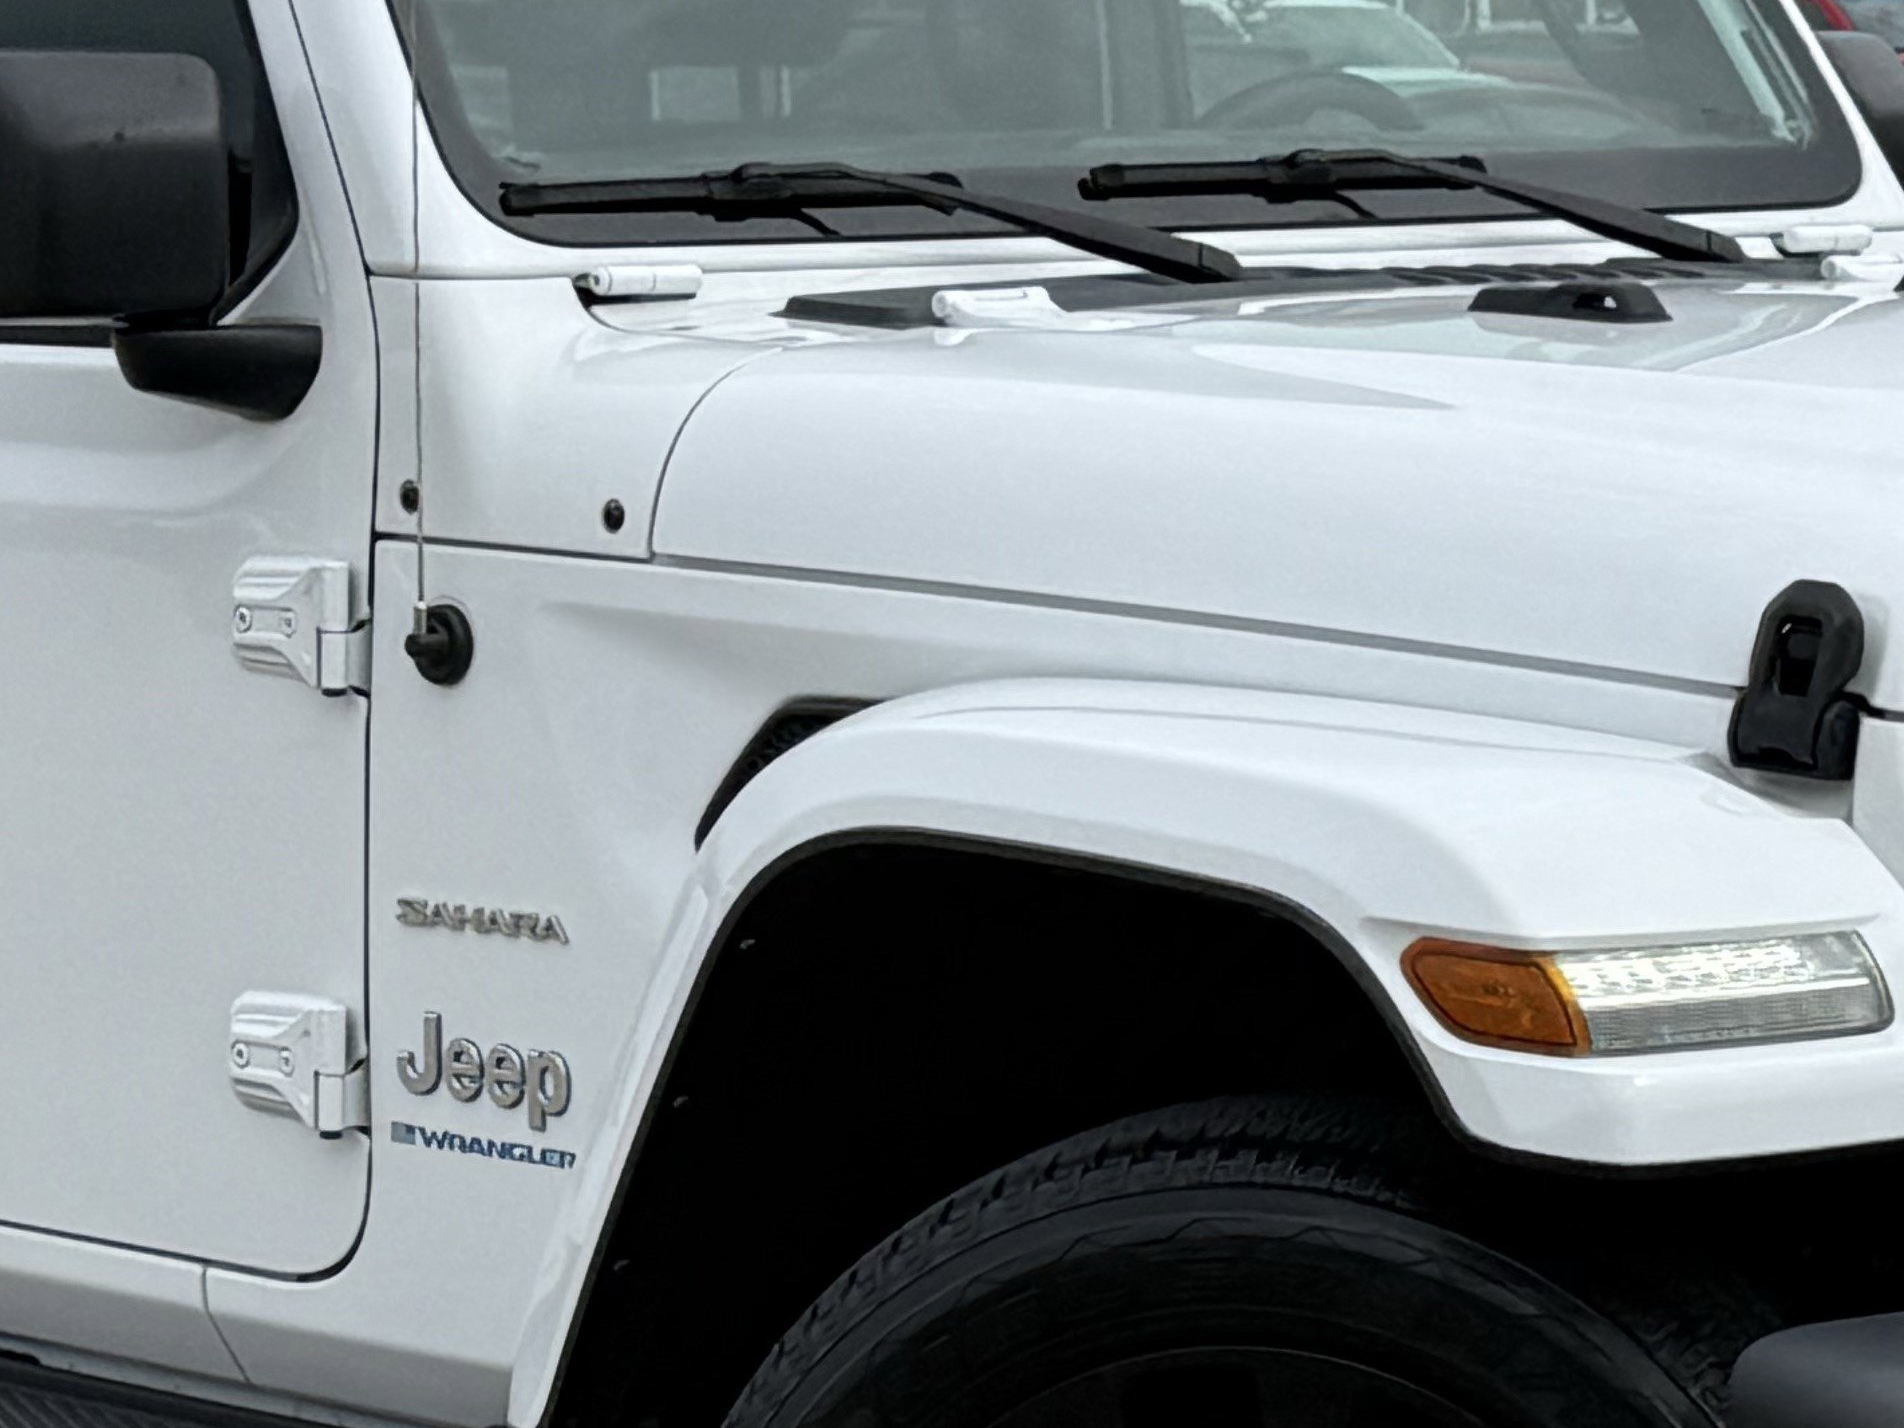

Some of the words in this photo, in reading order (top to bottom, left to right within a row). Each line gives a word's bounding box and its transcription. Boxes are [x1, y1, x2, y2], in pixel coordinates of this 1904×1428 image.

[395, 897, 570, 945] SAHARA
[396, 1010, 572, 1133] Jeep
[417, 1125, 576, 1170] WRANGLER
